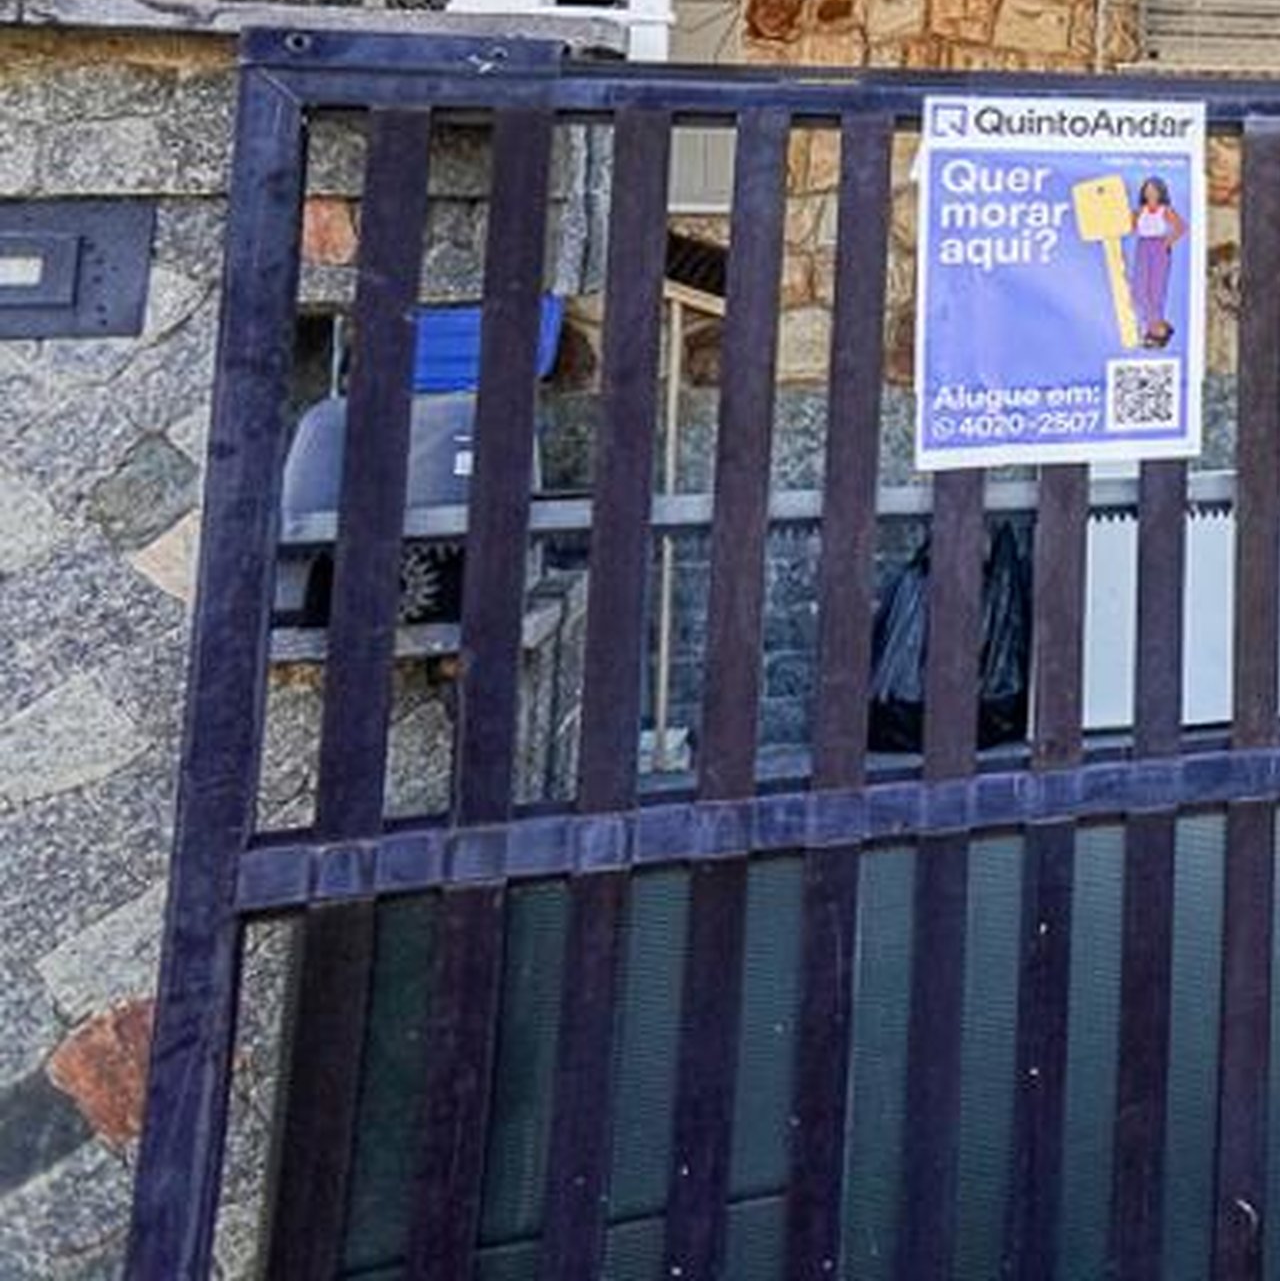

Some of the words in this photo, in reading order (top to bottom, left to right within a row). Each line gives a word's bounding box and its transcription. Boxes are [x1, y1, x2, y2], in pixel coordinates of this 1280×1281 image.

[973, 106, 1194, 138] QuintoAndar
[940, 159, 1052, 194] Quer
[940, 199, 1069, 229] morar
[939, 230, 1059, 270] aqui?
[932, 385, 1041, 415] Alugue
[1047, 385, 1100, 407] em:
